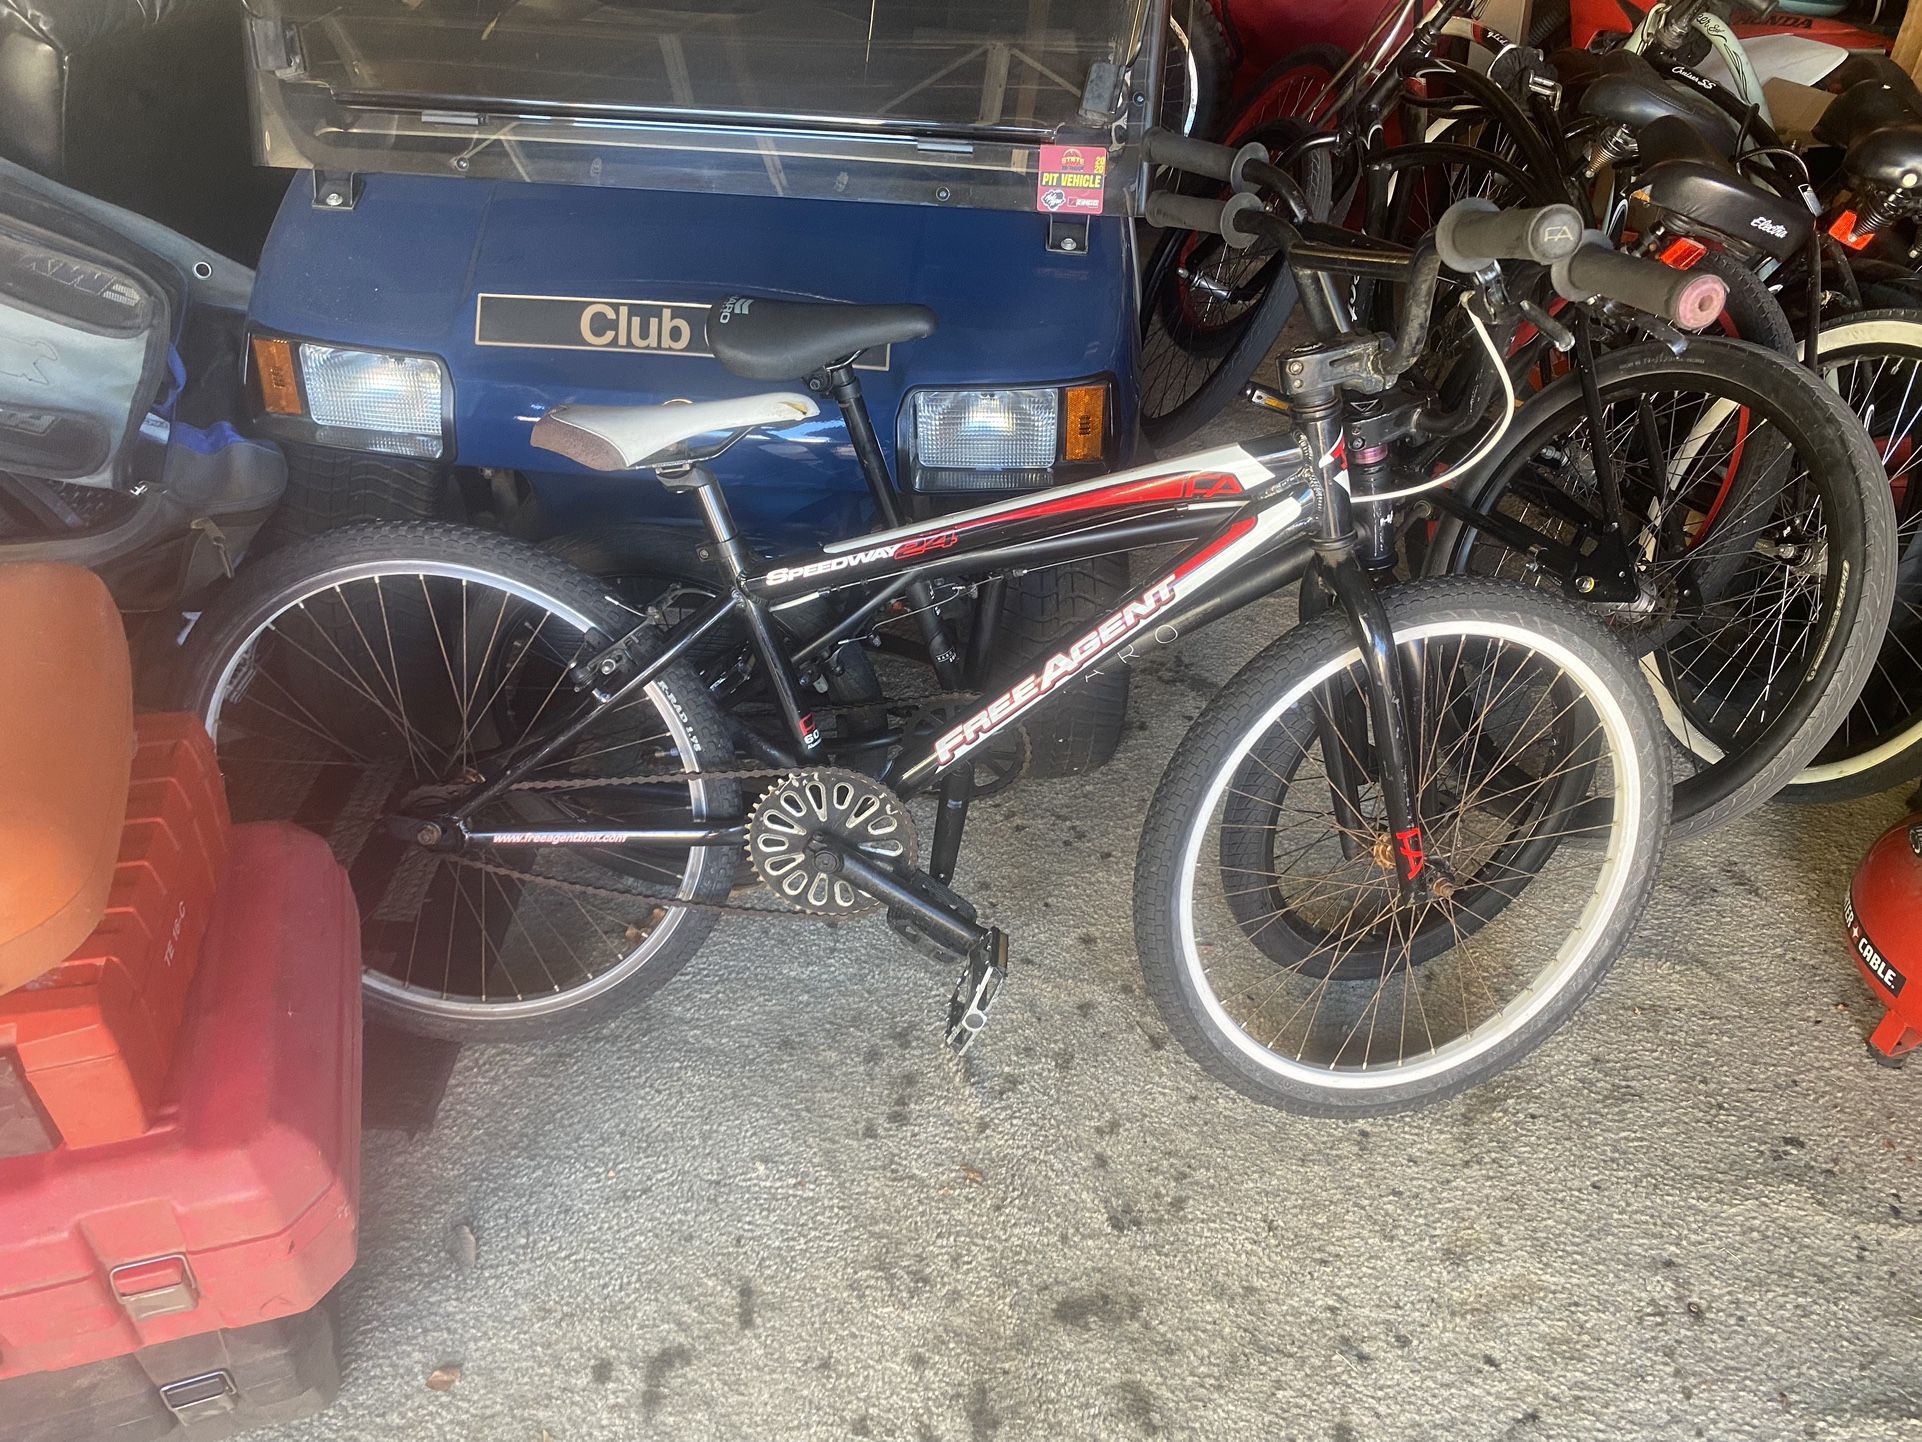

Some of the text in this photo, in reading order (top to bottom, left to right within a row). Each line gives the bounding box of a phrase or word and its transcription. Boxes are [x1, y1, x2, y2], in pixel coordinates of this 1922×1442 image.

[1042, 173, 1102, 188] PIT VEHICLE
[1750, 216, 1788, 239] Electra
[580, 303, 691, 350] Club
[893, 530, 959, 560] 24
[493, 832, 627, 845] www.freeagentbmx.com
